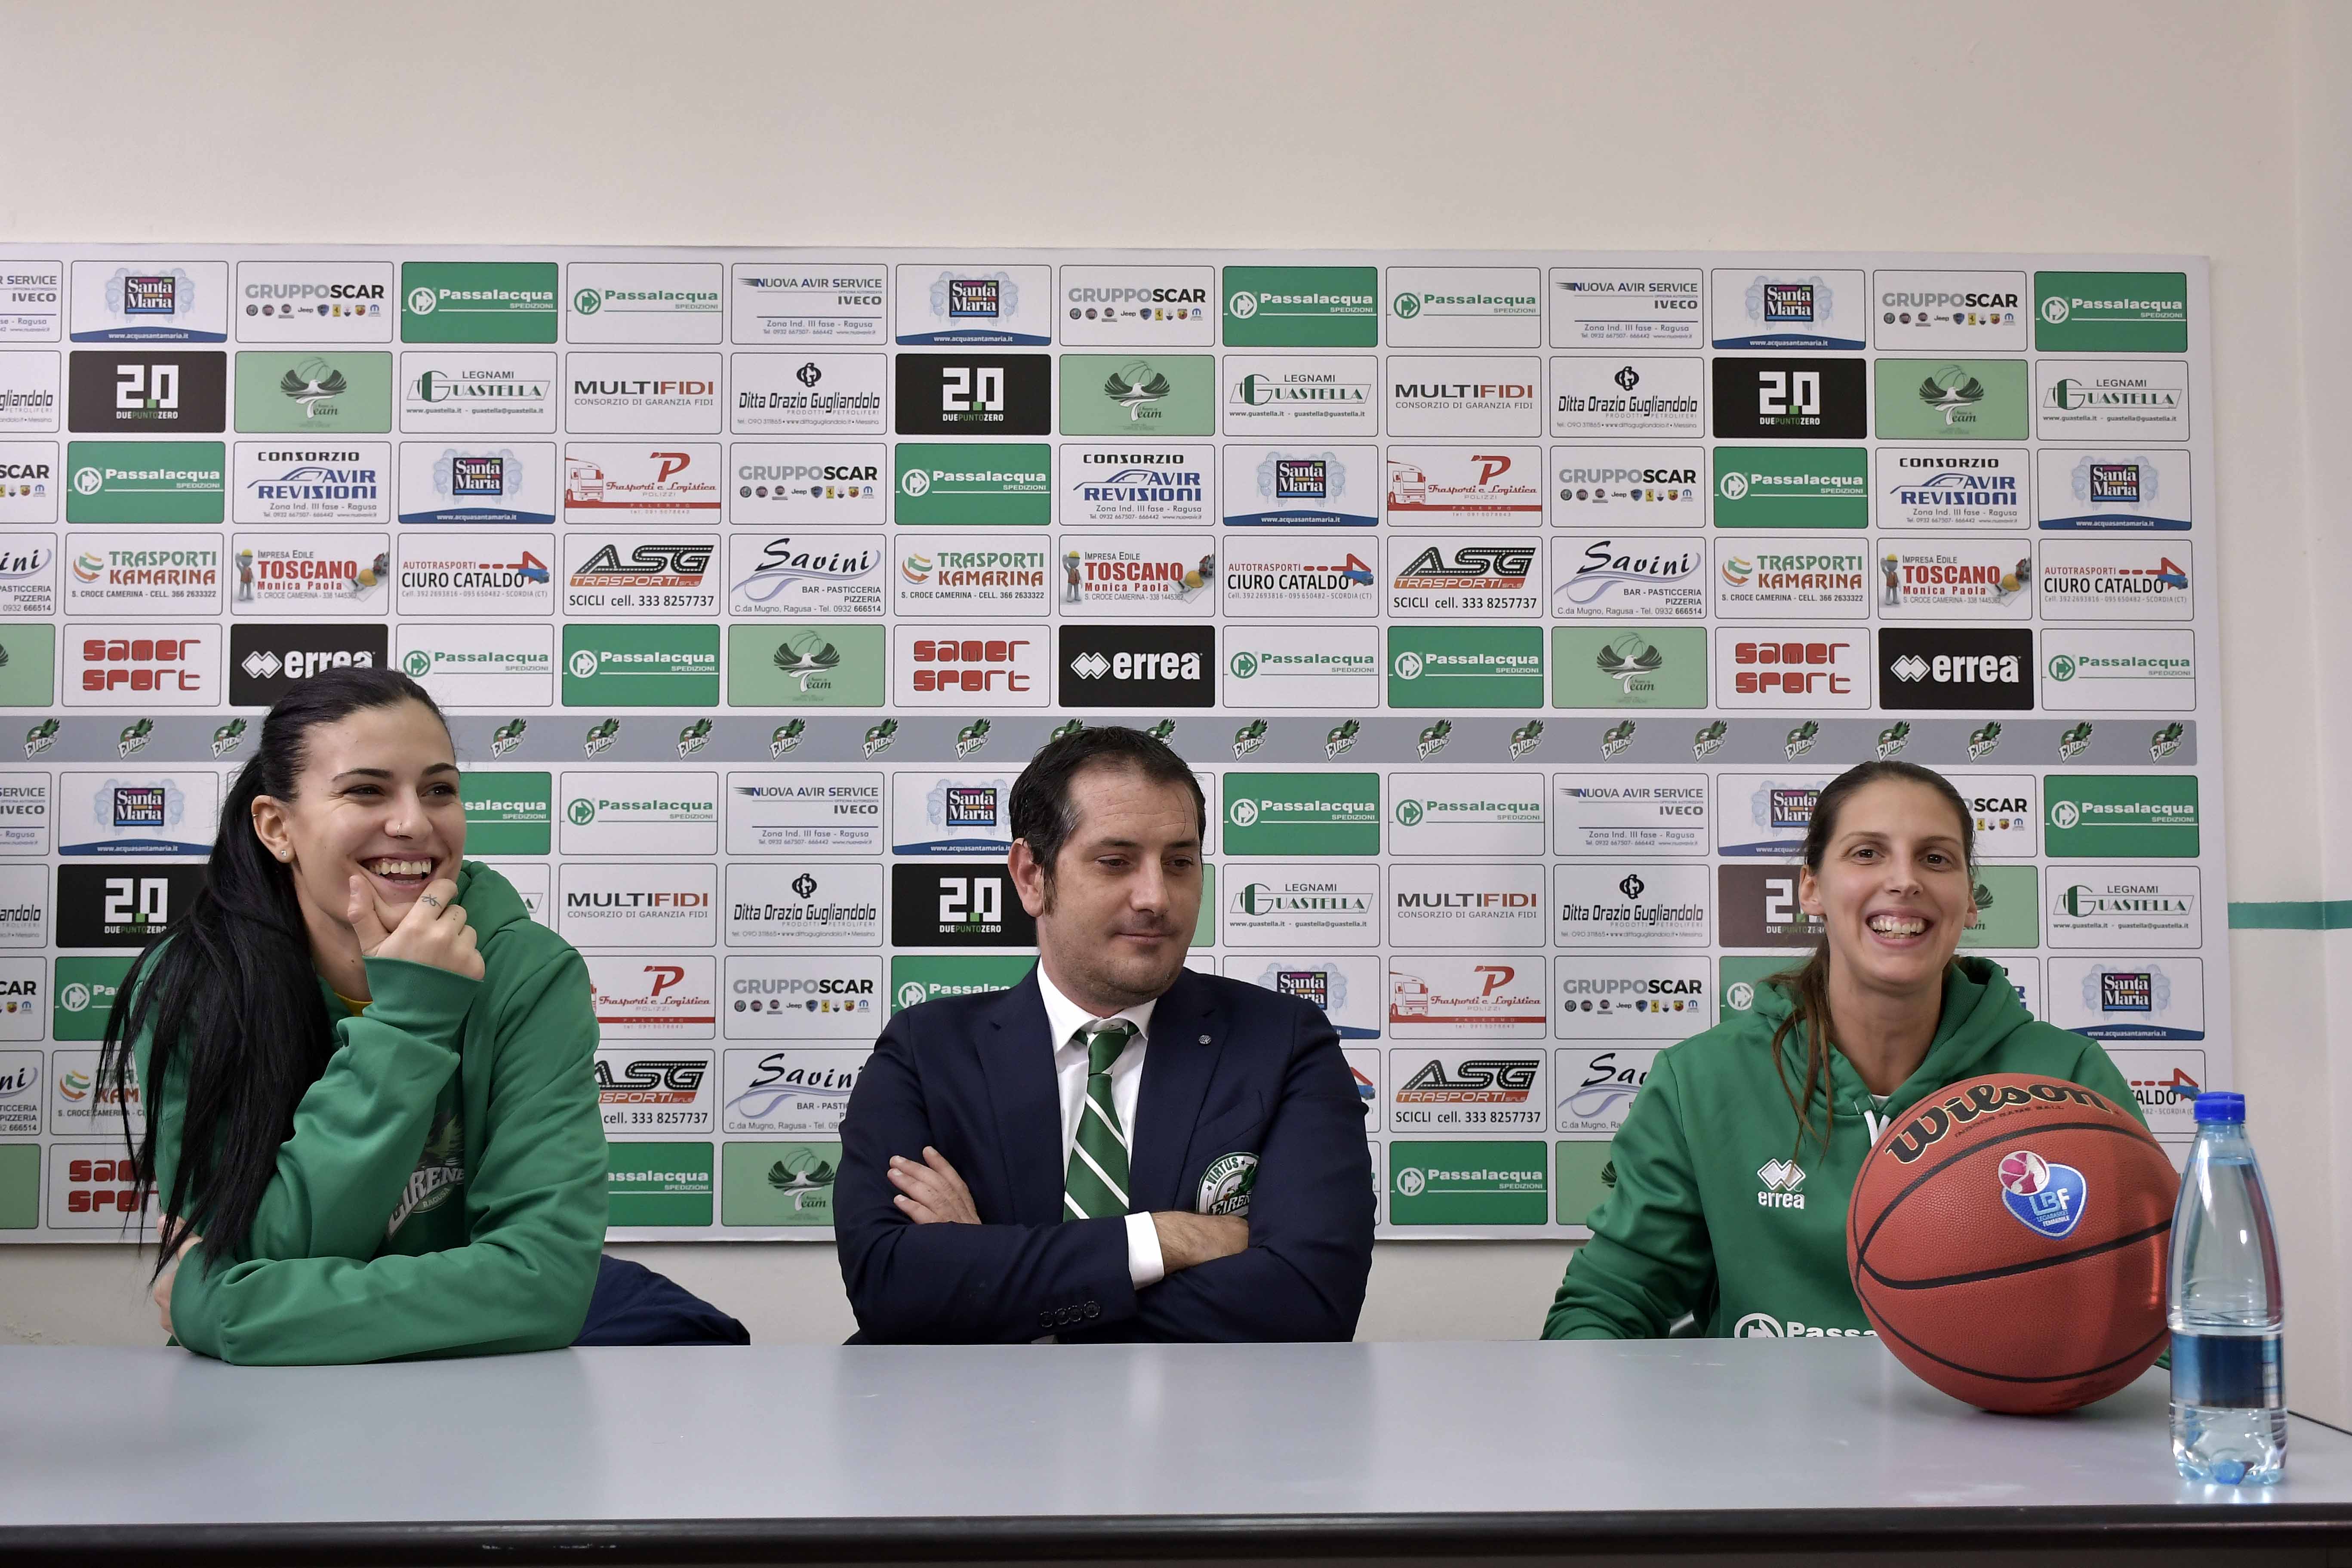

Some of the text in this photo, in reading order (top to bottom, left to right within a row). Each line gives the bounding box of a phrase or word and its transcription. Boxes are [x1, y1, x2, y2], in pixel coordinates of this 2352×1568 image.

[7, 275, 56, 284] SERVICE
[128, 279, 172, 293] Santa
[757, 278, 882, 287] NUOVA AVIR SERVICE
[12, 293, 56, 302] IVECO
[439, 289, 553, 302] Passalacqua
[604, 290, 718, 302] Passalacqua
[1260, 293, 1373, 306] Passalacqua
[1767, 286, 1810, 301] Santa
[127, 293, 172, 308] Maria
[838, 296, 881, 305] IVECO
[2071, 298, 2183, 311] Passalacqua
[1767, 301, 1811, 315] Maria
[417, 370, 542, 402] GUASTELLA
[574, 381, 713, 394] MULTIFIDI
[1239, 374, 1363, 405] GUASTELLA
[1395, 385, 1533, 398] MULTIFIDI
[739, 391, 880, 413] Ditta Orazio Gugliandolo
[1083, 454, 1184, 464] CONSORZIO
[105, 468, 220, 481] Passalacqua
[1279, 462, 1323, 477] Santa
[1147, 472, 1200, 485] AVIR
[1279, 477, 1323, 492] Maria
[1751, 474, 1863, 487] Passalacqua
[1084, 488, 1201, 501] REVISIONI
[1428, 484, 1476, 494] Trasporti
[1488, 484, 1537, 495] Logistica
[1173, 505, 1201, 513] Ragusa
[109, 551, 216, 567] TRASPORTI
[937, 552, 1044, 568] TRASPORTI
[1398, 546, 1536, 576] ASG
[109, 569, 215, 585] KAMARINA
[1084, 562, 1183, 581] TOSCANO
[1902, 566, 2000, 584] TOSCANO
[401, 573, 524, 588] CIURO CATALDO
[938, 570, 1043, 587] KAMARINA
[1227, 574, 1348, 589] CIURO CATALDO
[1398, 579, 1502, 588] TRASPORTI
[1085, 582, 1168, 591] Monica Paola
[755, 605, 782, 613] Mugno,
[784, 605, 811, 613] Ragusa
[1393, 597, 1537, 608] SCICLI cell. 333 8257737
[1261, 653, 1374, 665] Passalacqua
[2078, 656, 2191, 668] Passalacqua
[117, 790, 162, 804] Santa
[117, 805, 162, 819] Maria
[598, 800, 713, 812] Passalacqua
[2081, 802, 2195, 815] Passalacqua
[2104, 975, 2148, 990] Santa
[2104, 990, 2149, 1005] Maria
[1400, 1059, 1540, 1090] ASG
[656, 1112, 708, 1123] 8257737
[1395, 1111, 1541, 1122] SCICLI 8257737
[1206, 1156, 1239, 1185] VIRTUS
[1428, 1168, 1543, 1182] Passalacqua
[423, 1187, 451, 1208] RAGUSA
[2029, 1188, 2070, 1216] LBF
